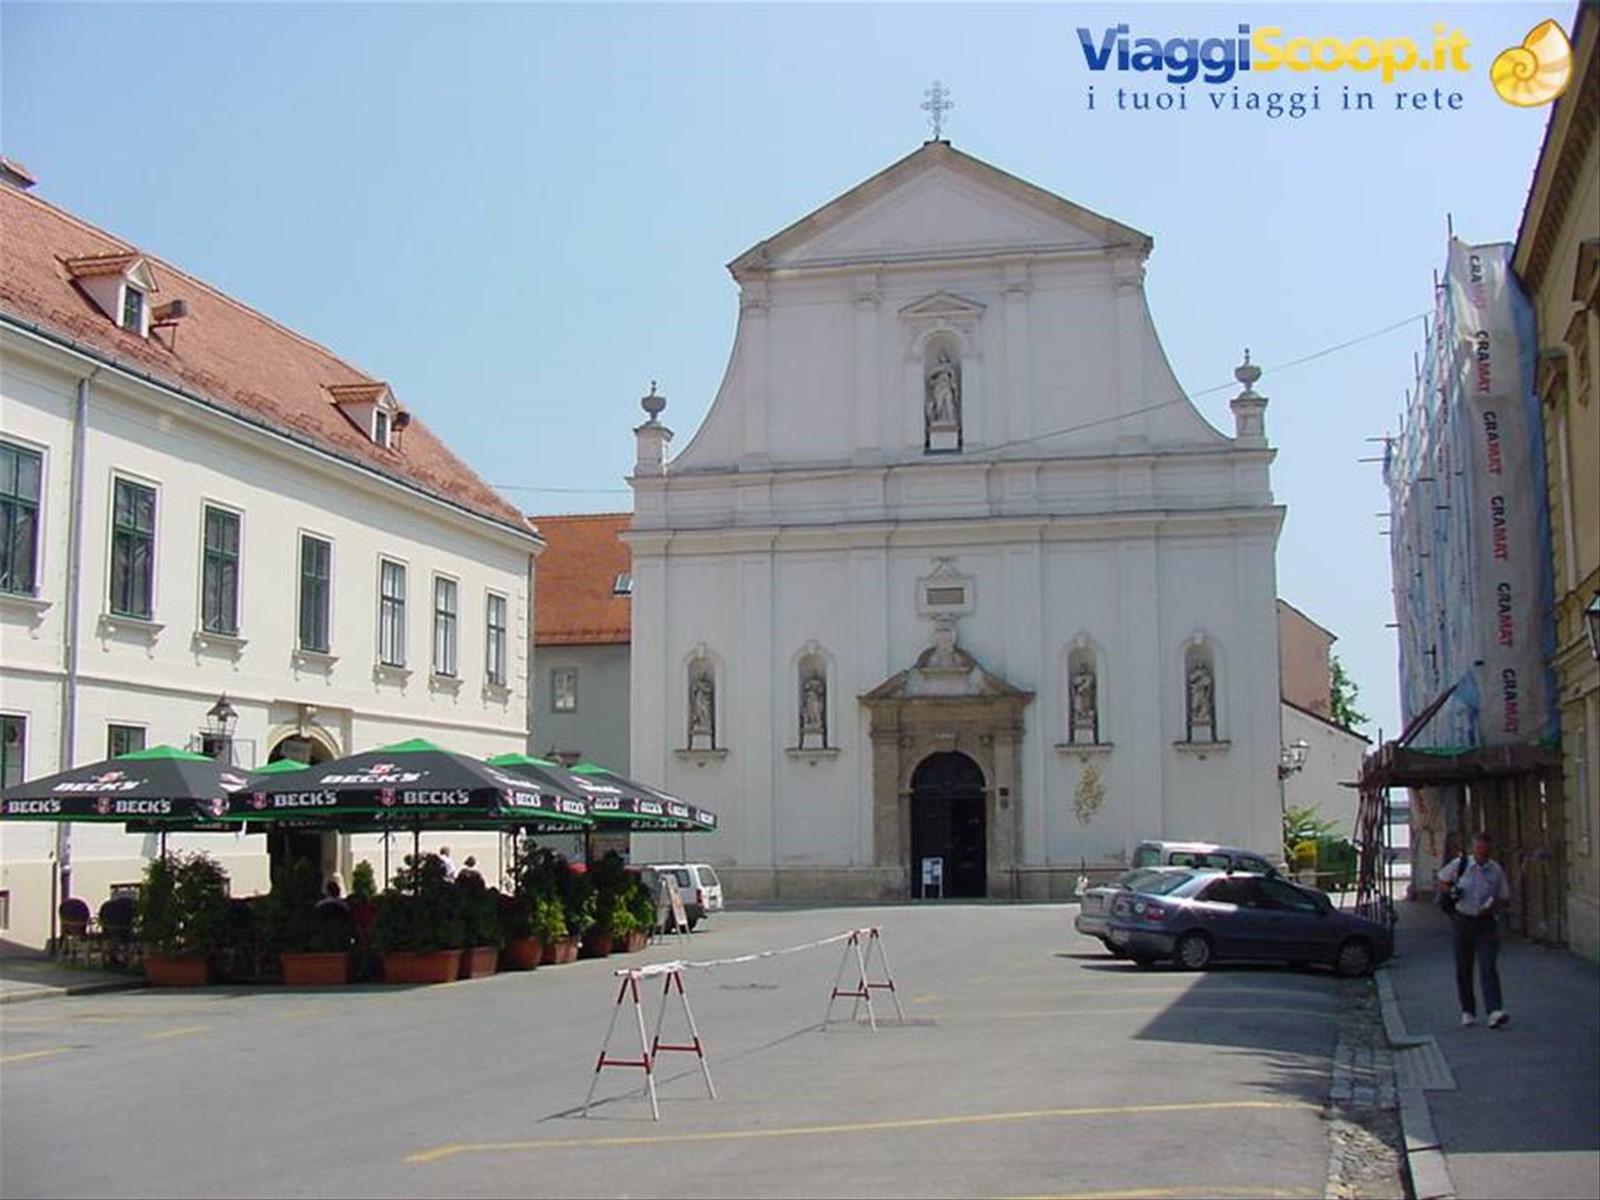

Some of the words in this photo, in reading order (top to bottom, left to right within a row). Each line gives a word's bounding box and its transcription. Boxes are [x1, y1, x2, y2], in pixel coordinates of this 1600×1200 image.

[274, 789, 338, 807] BECK'S
[403, 789, 470, 806] BECK'S
[8, 798, 61, 814] BECK'S
[115, 799, 171, 814] BECK'S
